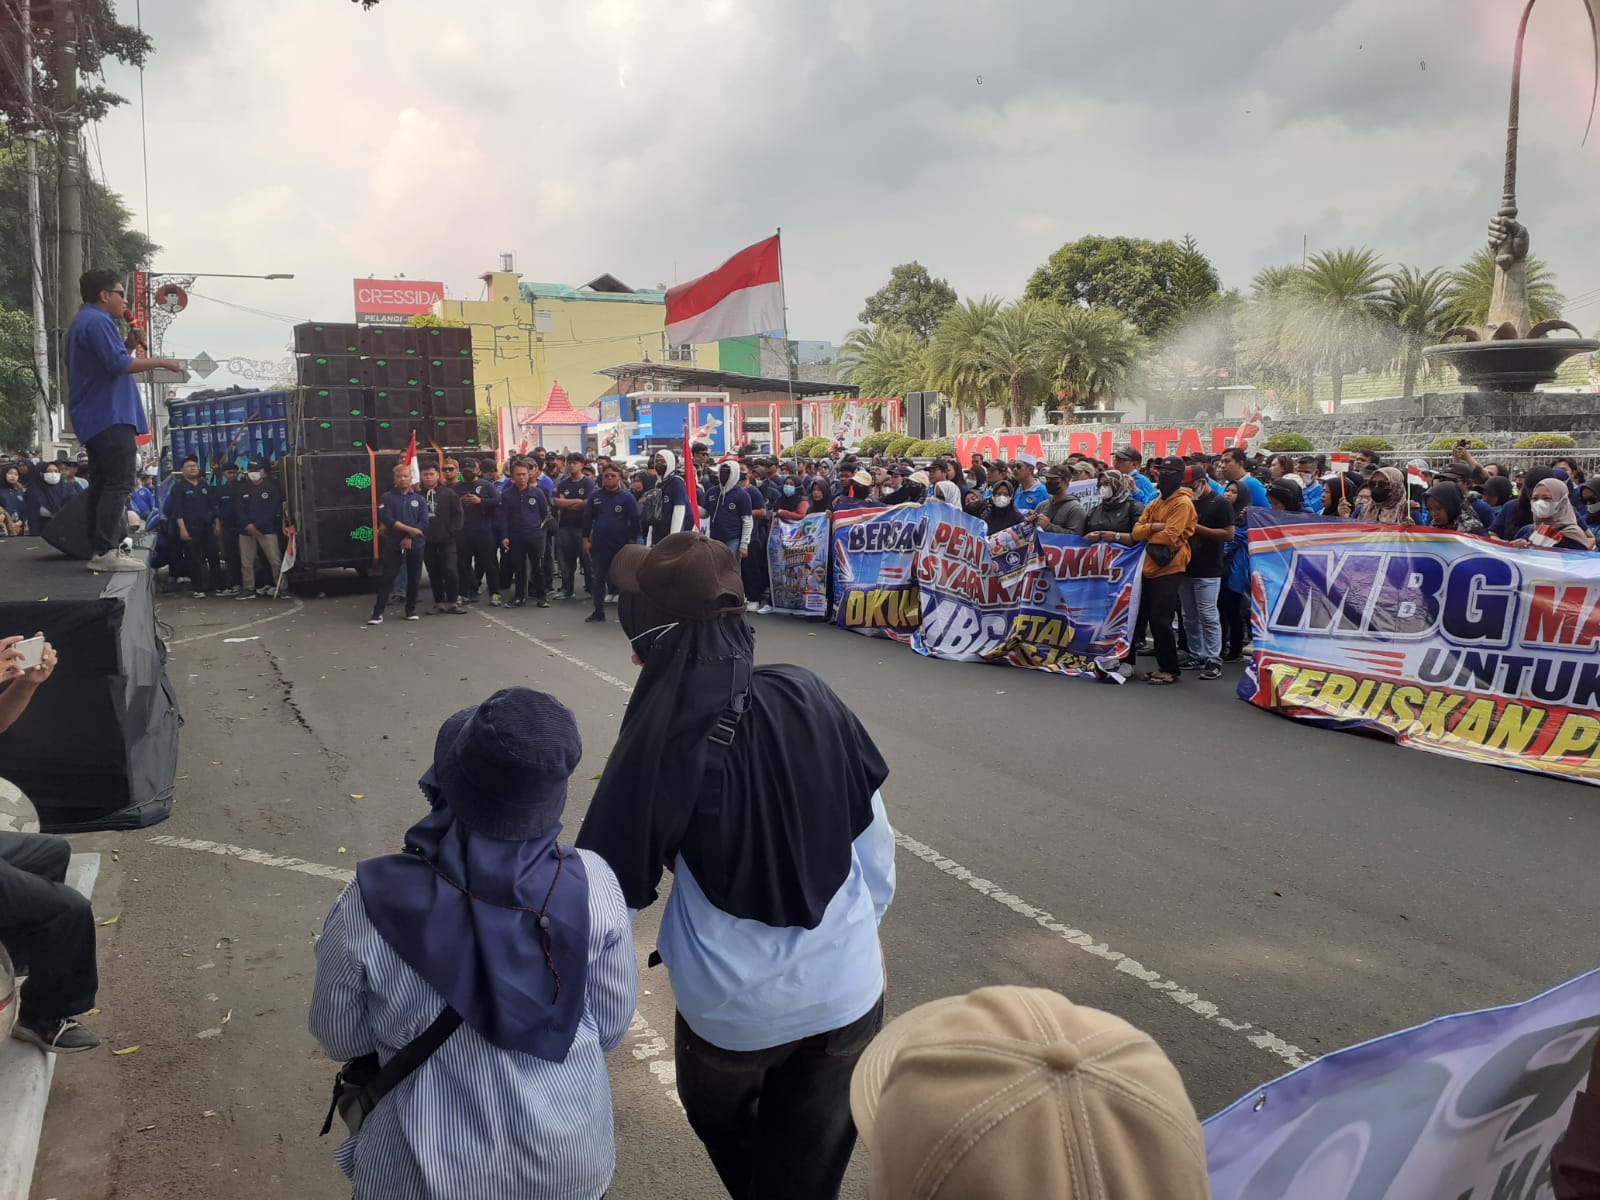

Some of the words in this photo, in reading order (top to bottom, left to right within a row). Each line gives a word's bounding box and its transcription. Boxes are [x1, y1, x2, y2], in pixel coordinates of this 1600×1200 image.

[358, 287, 441, 305] CRESSIDA
[364, 313, 403, 323] PELANGI
[956, 433, 1045, 469] KOTA
[1268, 552, 1517, 648] MBG
[1267, 664, 1547, 754] TERUSKAN
[1539, 713, 1600, 765] P
